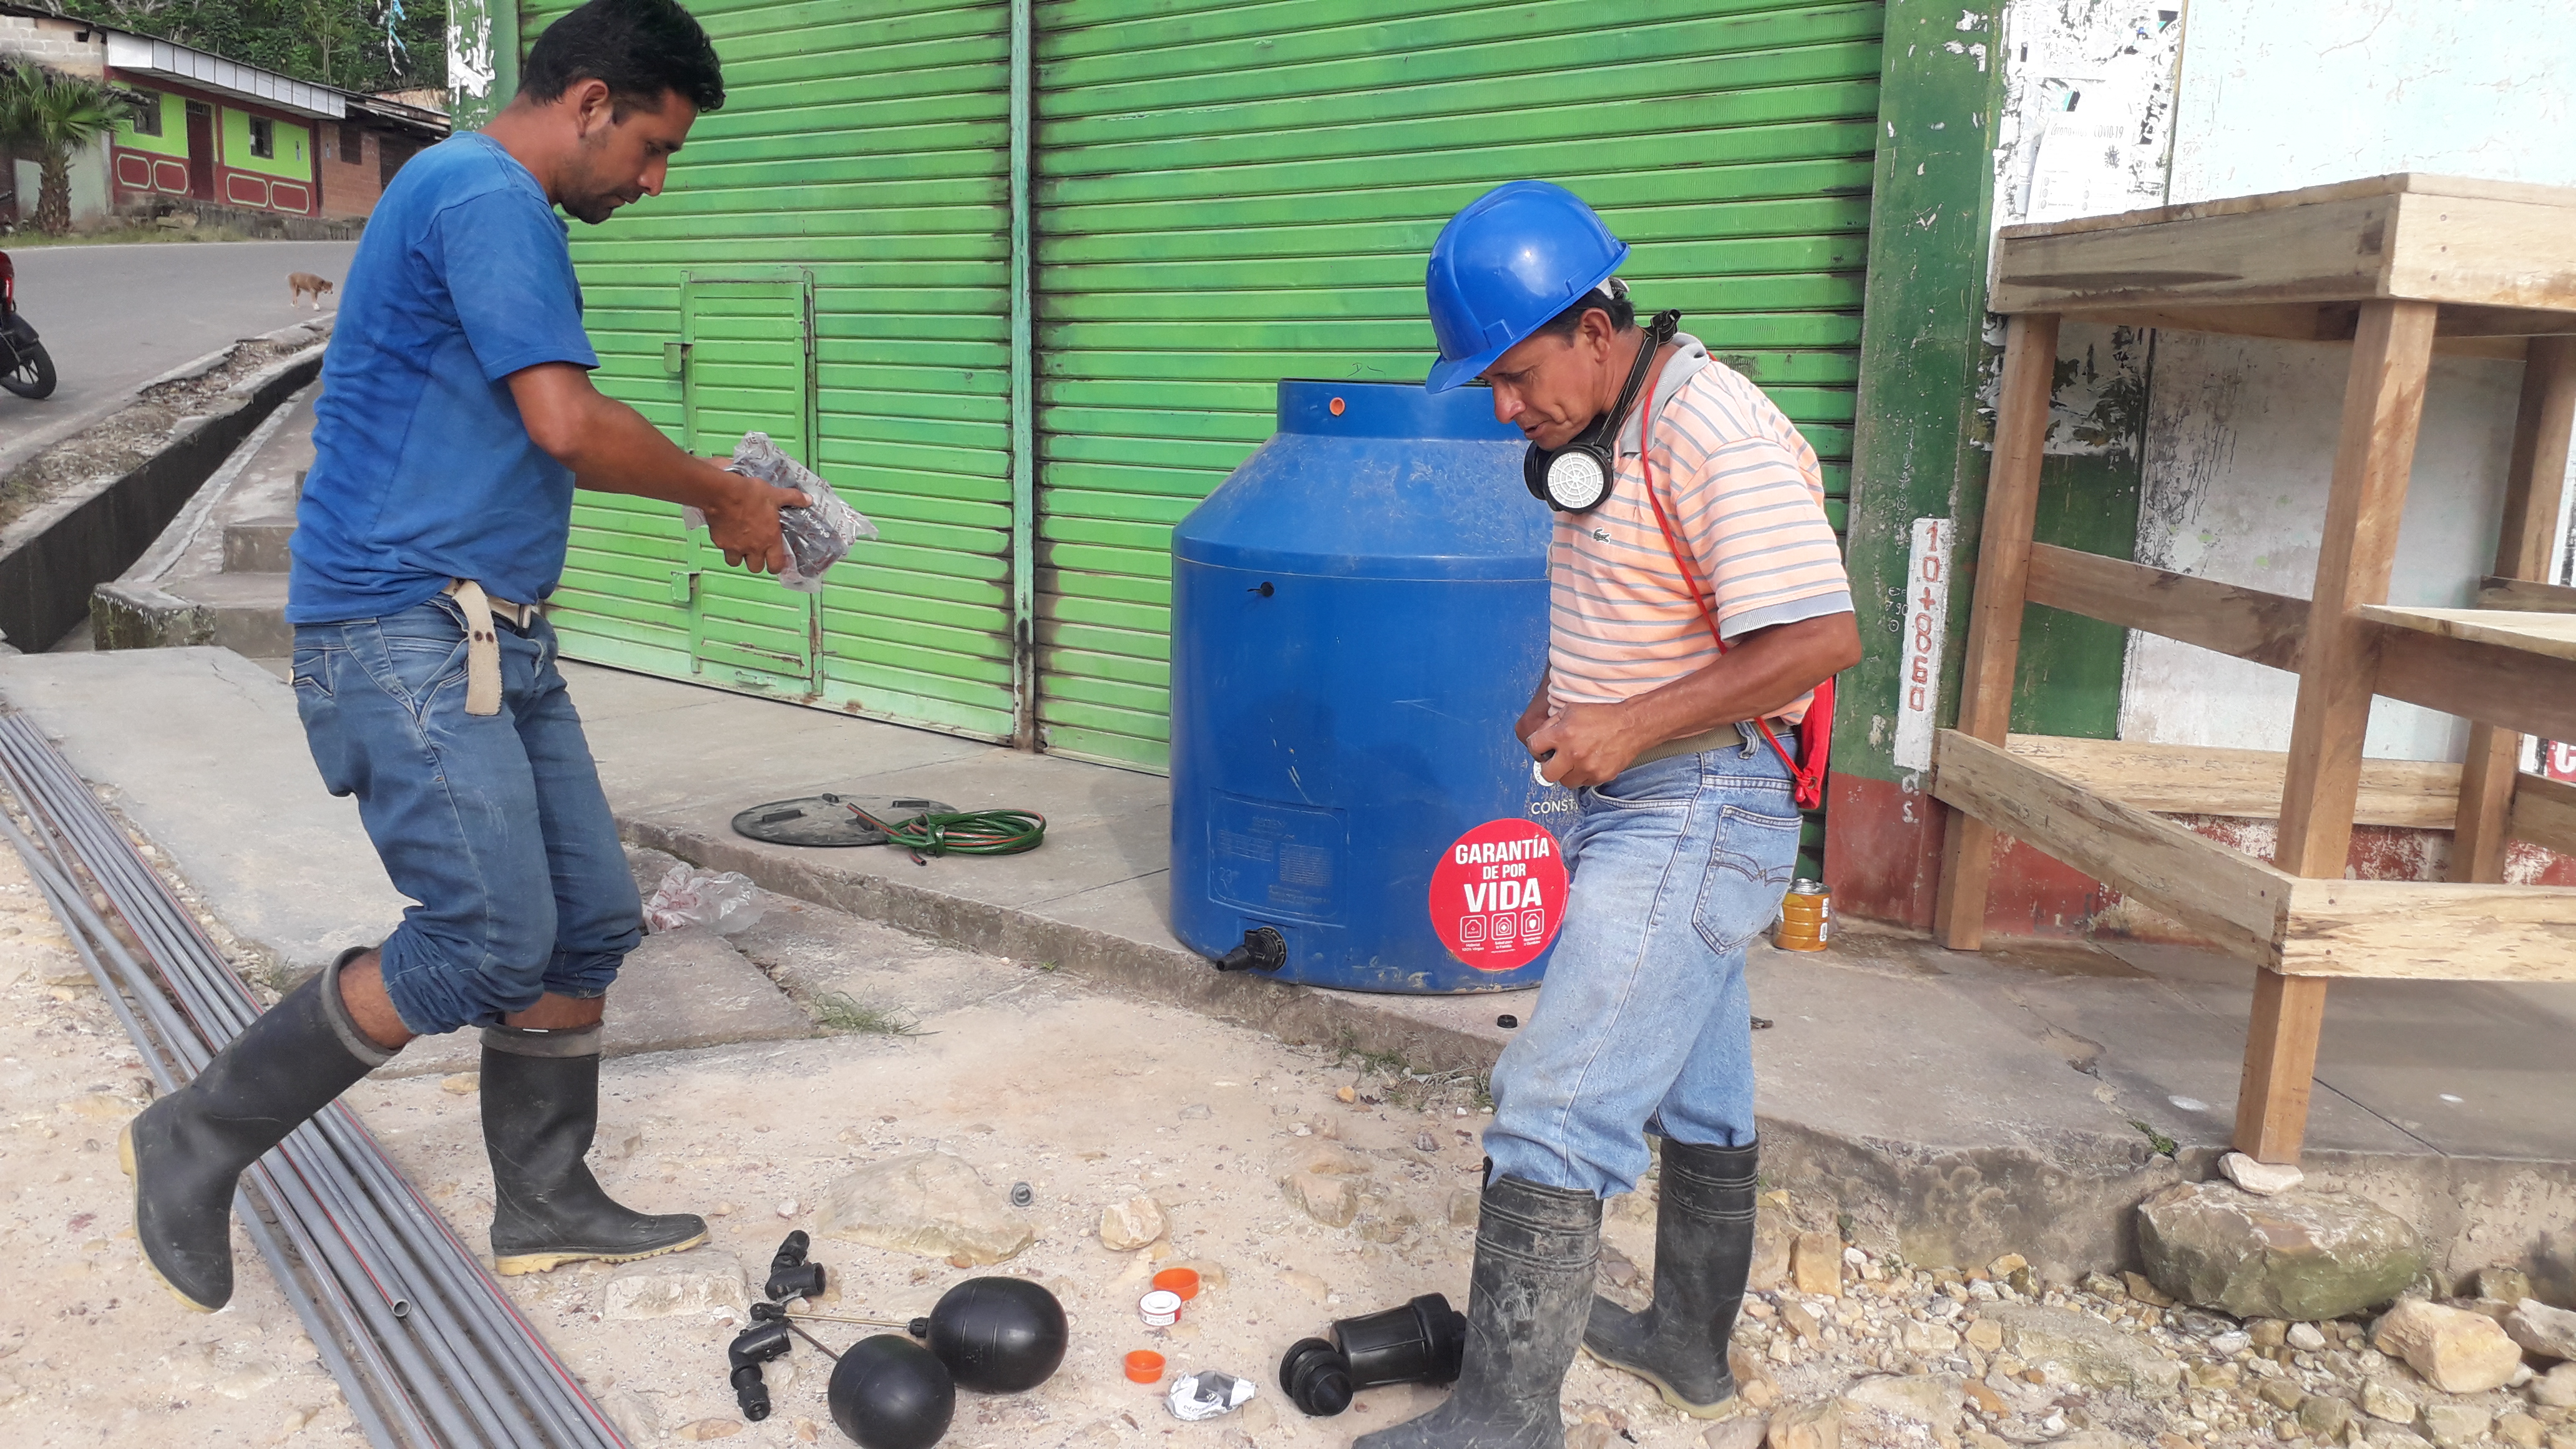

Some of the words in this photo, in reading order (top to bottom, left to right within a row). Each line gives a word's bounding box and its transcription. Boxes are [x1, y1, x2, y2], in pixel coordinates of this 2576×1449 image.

[1455, 834, 1549, 865] GARANTÍA
[1483, 865, 1499, 880] DE
[1503, 863, 1526, 878] POR
[1463, 877, 1542, 913] VIDA
